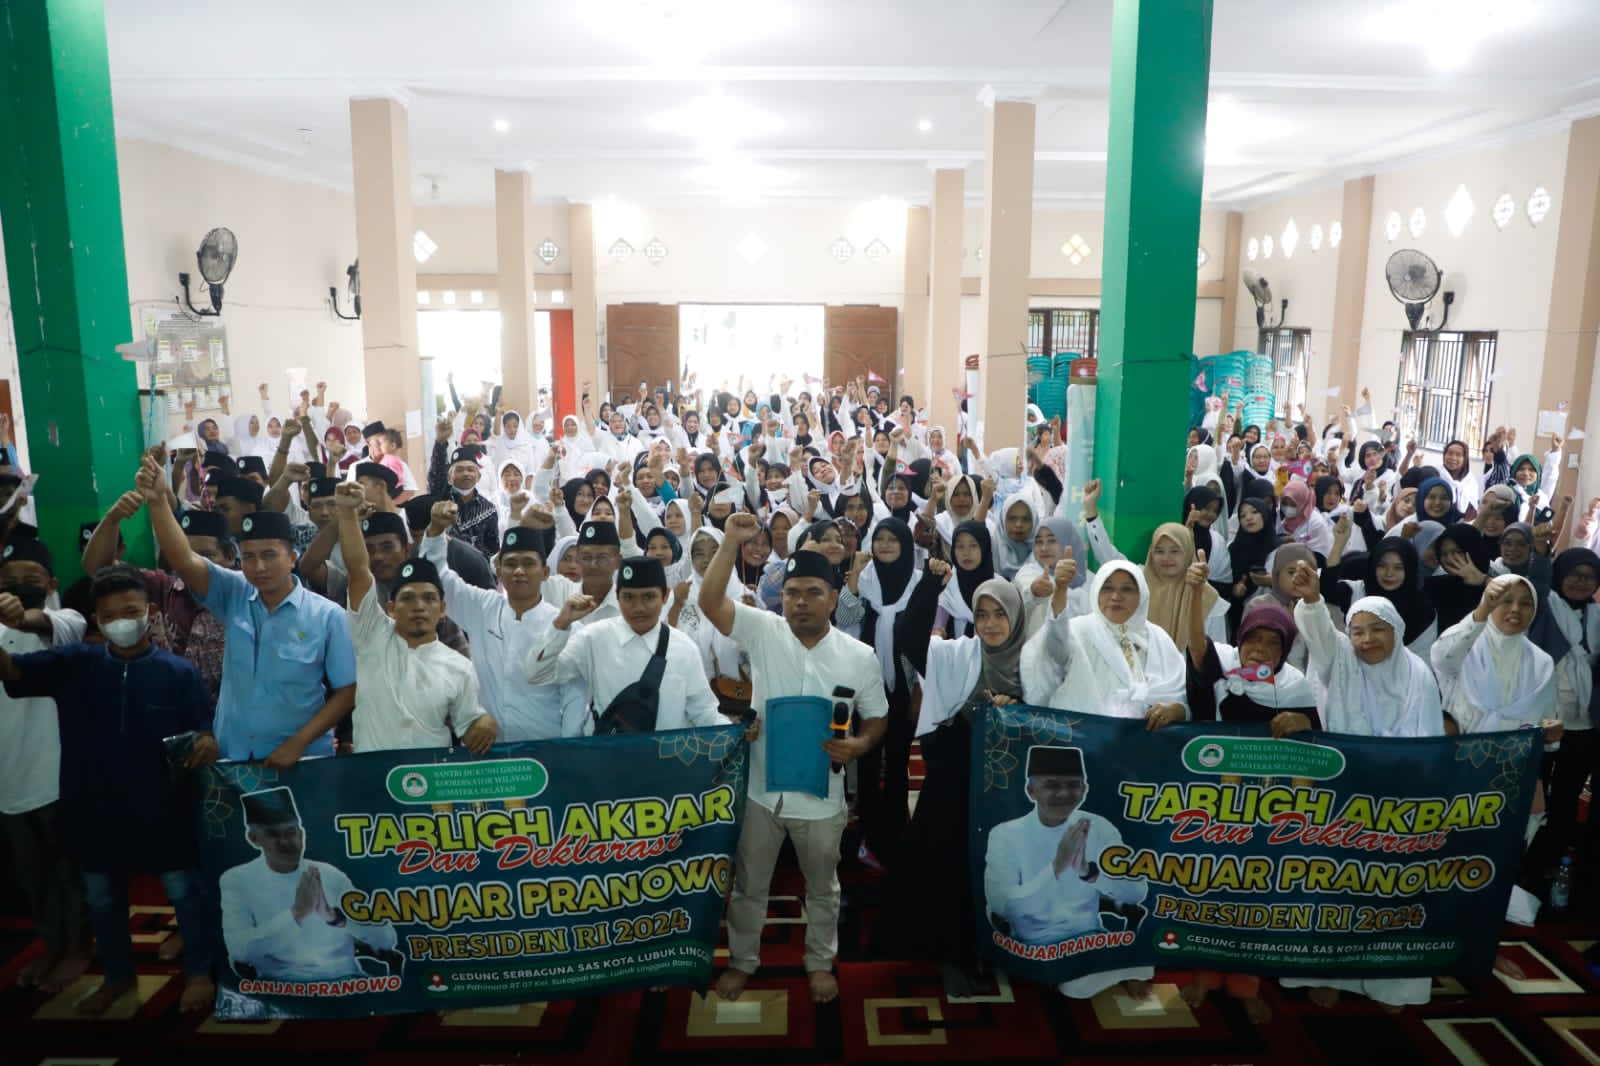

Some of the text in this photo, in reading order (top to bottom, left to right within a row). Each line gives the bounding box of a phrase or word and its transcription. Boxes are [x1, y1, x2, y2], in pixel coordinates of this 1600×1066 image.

[337, 786, 734, 857] TABLIGH AKBAR
[1120, 783, 1504, 834] TABLIGH AKBAR
[395, 830, 683, 874] Dan Deklarasi
[1171, 809, 1450, 853] Dan Deklarasi
[341, 855, 731, 928] GANJAR PRANOWO
[1100, 846, 1495, 897] GANJAR PRANOWO
[409, 908, 691, 960] PRESIDEN RI 2024
[1154, 896, 1426, 932] PRESIDEN RI 2024
[451, 971, 500, 981] GEDUNG
[503, 965, 575, 980] SERBAGUNA
[578, 961, 600, 972] SAS
[603, 956, 635, 969] KOTA
[637, 947, 676, 962] LUBUK
[993, 930, 1136, 961] GANJAR PRANOWO
[1186, 934, 1237, 948] GEDUNG
[1240, 941, 1309, 953] SERBAGUNA
[1312, 944, 1334, 954] SAS
[1367, 941, 1403, 952] LUBUK
[1406, 940, 1456, 951] LINGGAU
[239, 975, 402, 997] GANJAR PRANOWO
